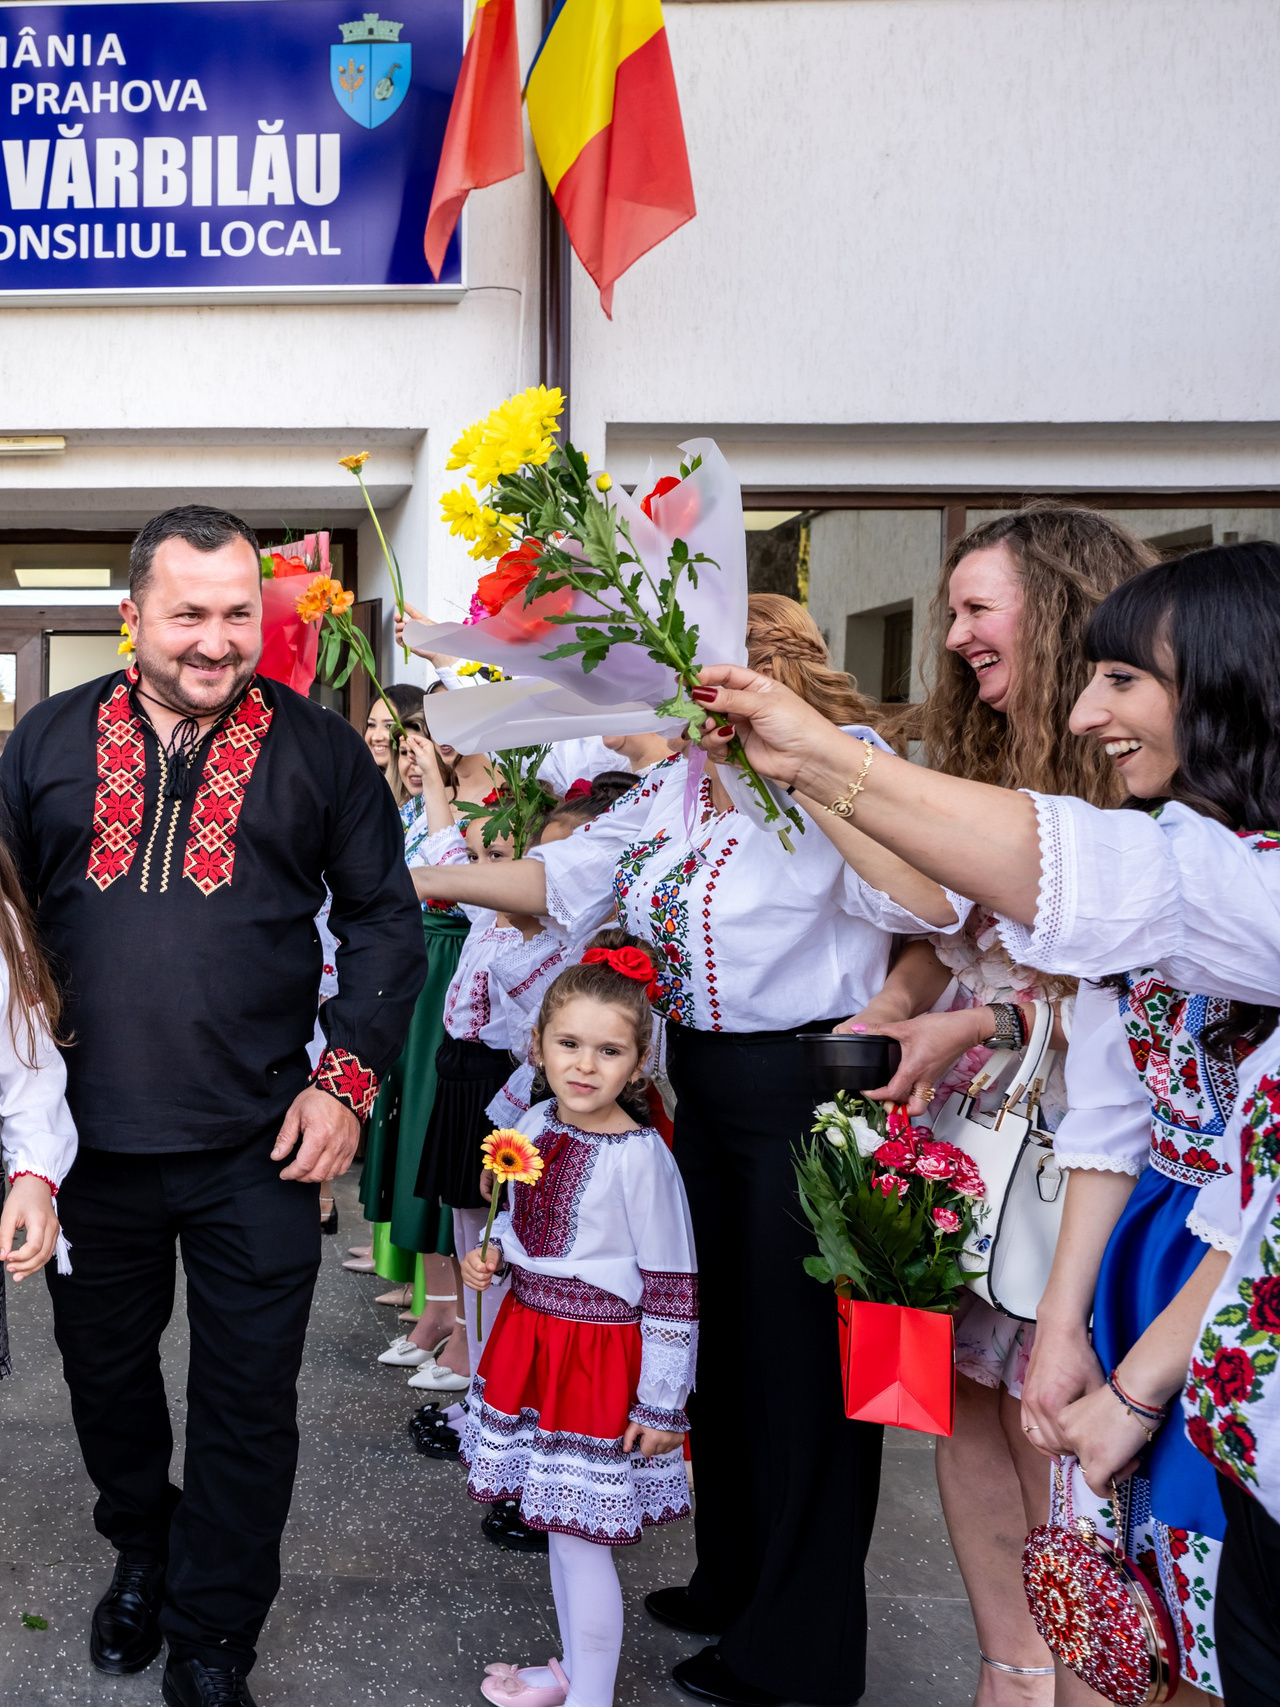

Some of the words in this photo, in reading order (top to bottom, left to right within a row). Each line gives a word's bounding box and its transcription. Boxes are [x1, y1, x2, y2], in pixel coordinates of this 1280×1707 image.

[11, 78, 208, 116] PRAHOVA
[1, 118, 341, 210] VĂRBILĂU
[200, 219, 342, 258] LOCAL
